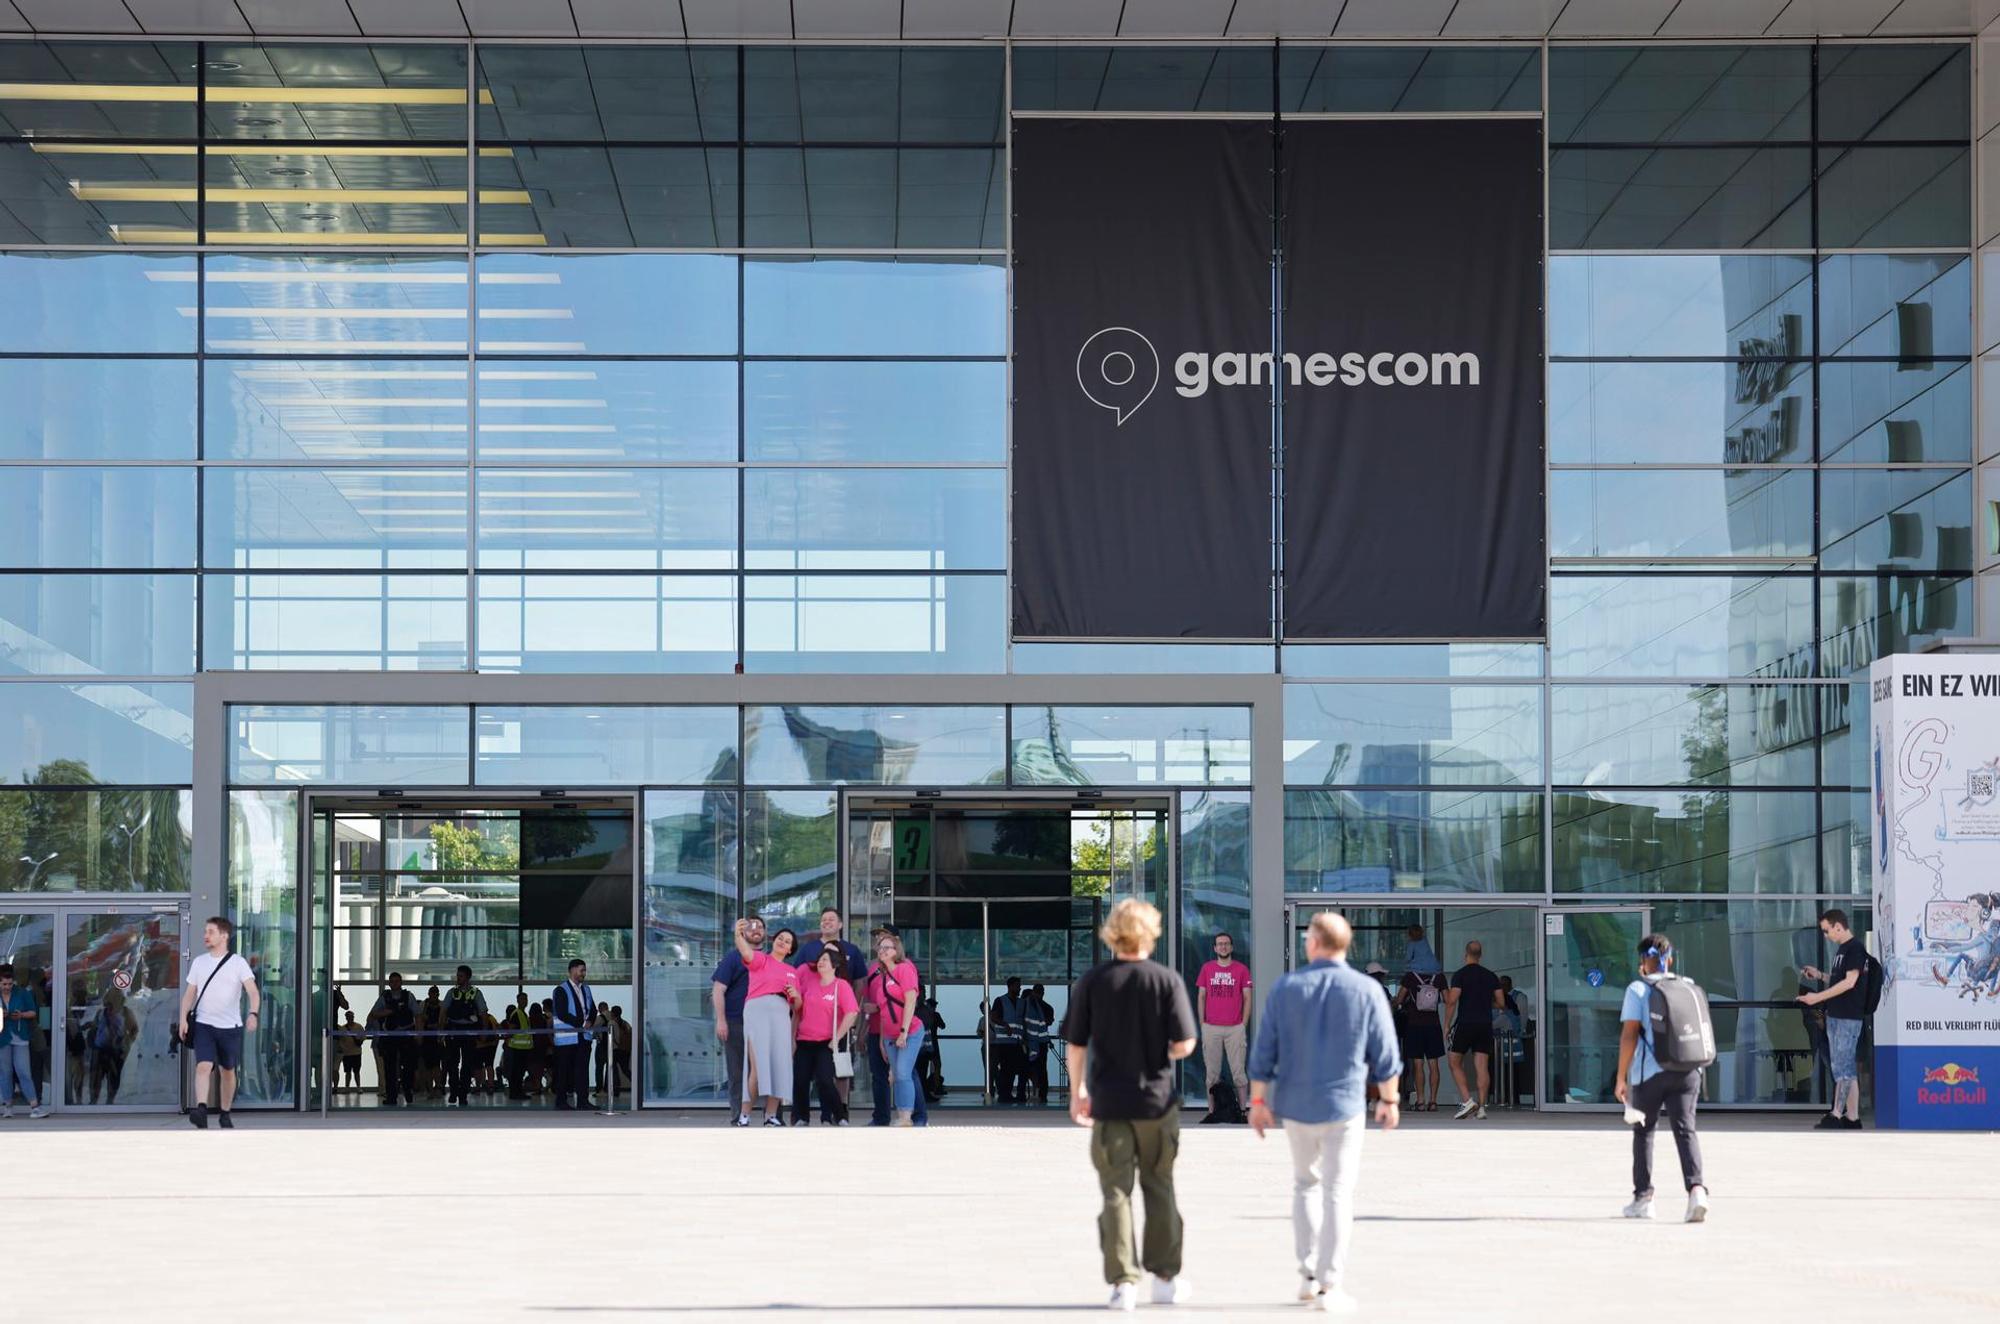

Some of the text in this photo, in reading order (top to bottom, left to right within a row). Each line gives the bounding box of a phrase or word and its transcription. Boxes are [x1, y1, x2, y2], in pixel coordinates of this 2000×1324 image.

[1174, 351, 1480, 398] gamescom
[1902, 674, 1933, 697] EIN
[1940, 674, 1964, 697] EZ
[1906, 1020, 1922, 1030] RED
[1923, 1020, 1943, 1030] BULL
[1944, 1020, 1981, 1030] VERLEIHT
[1917, 1087, 1987, 1105] Red Bull
